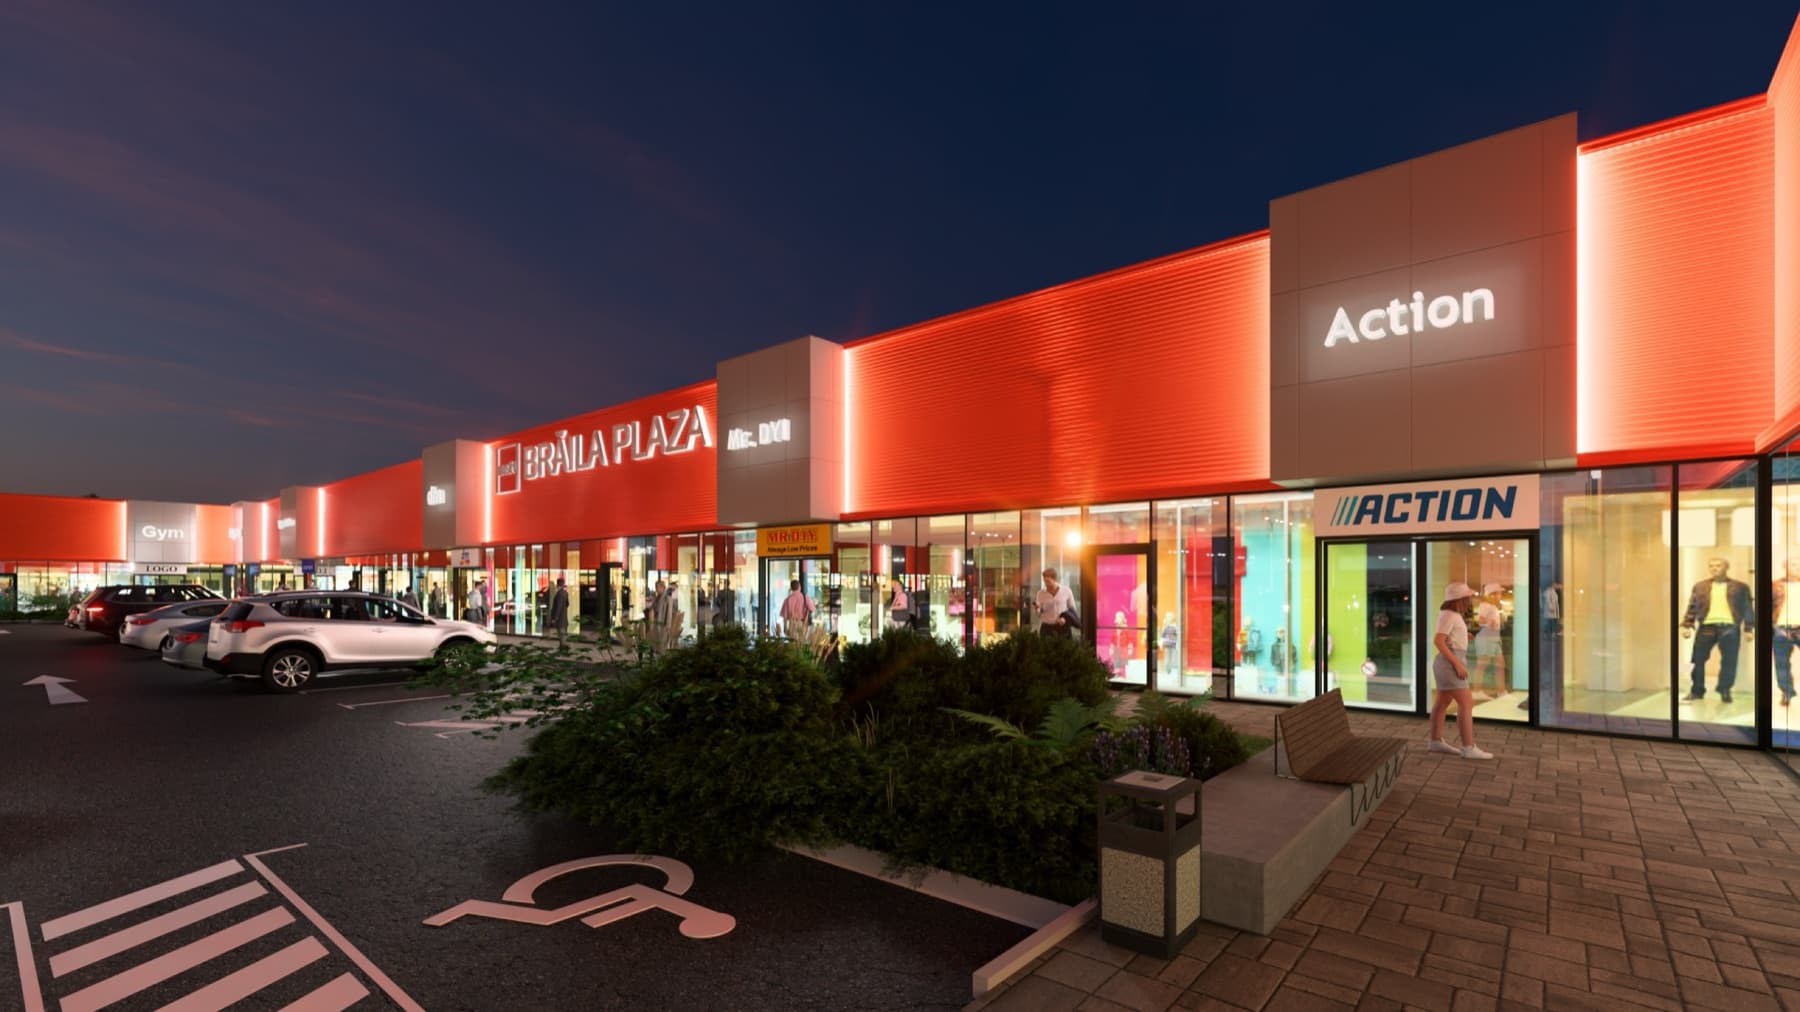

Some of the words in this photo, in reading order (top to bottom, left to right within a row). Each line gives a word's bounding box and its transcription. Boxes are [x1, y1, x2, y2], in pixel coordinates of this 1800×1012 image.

[1324, 288, 1496, 348] Action
[523, 430, 609, 480] BRĂILA
[612, 405, 714, 465] PLAZA
[1352, 485, 1518, 526] ACTION
[142, 525, 185, 541] Gym
[146, 564, 178, 573] LOGO
